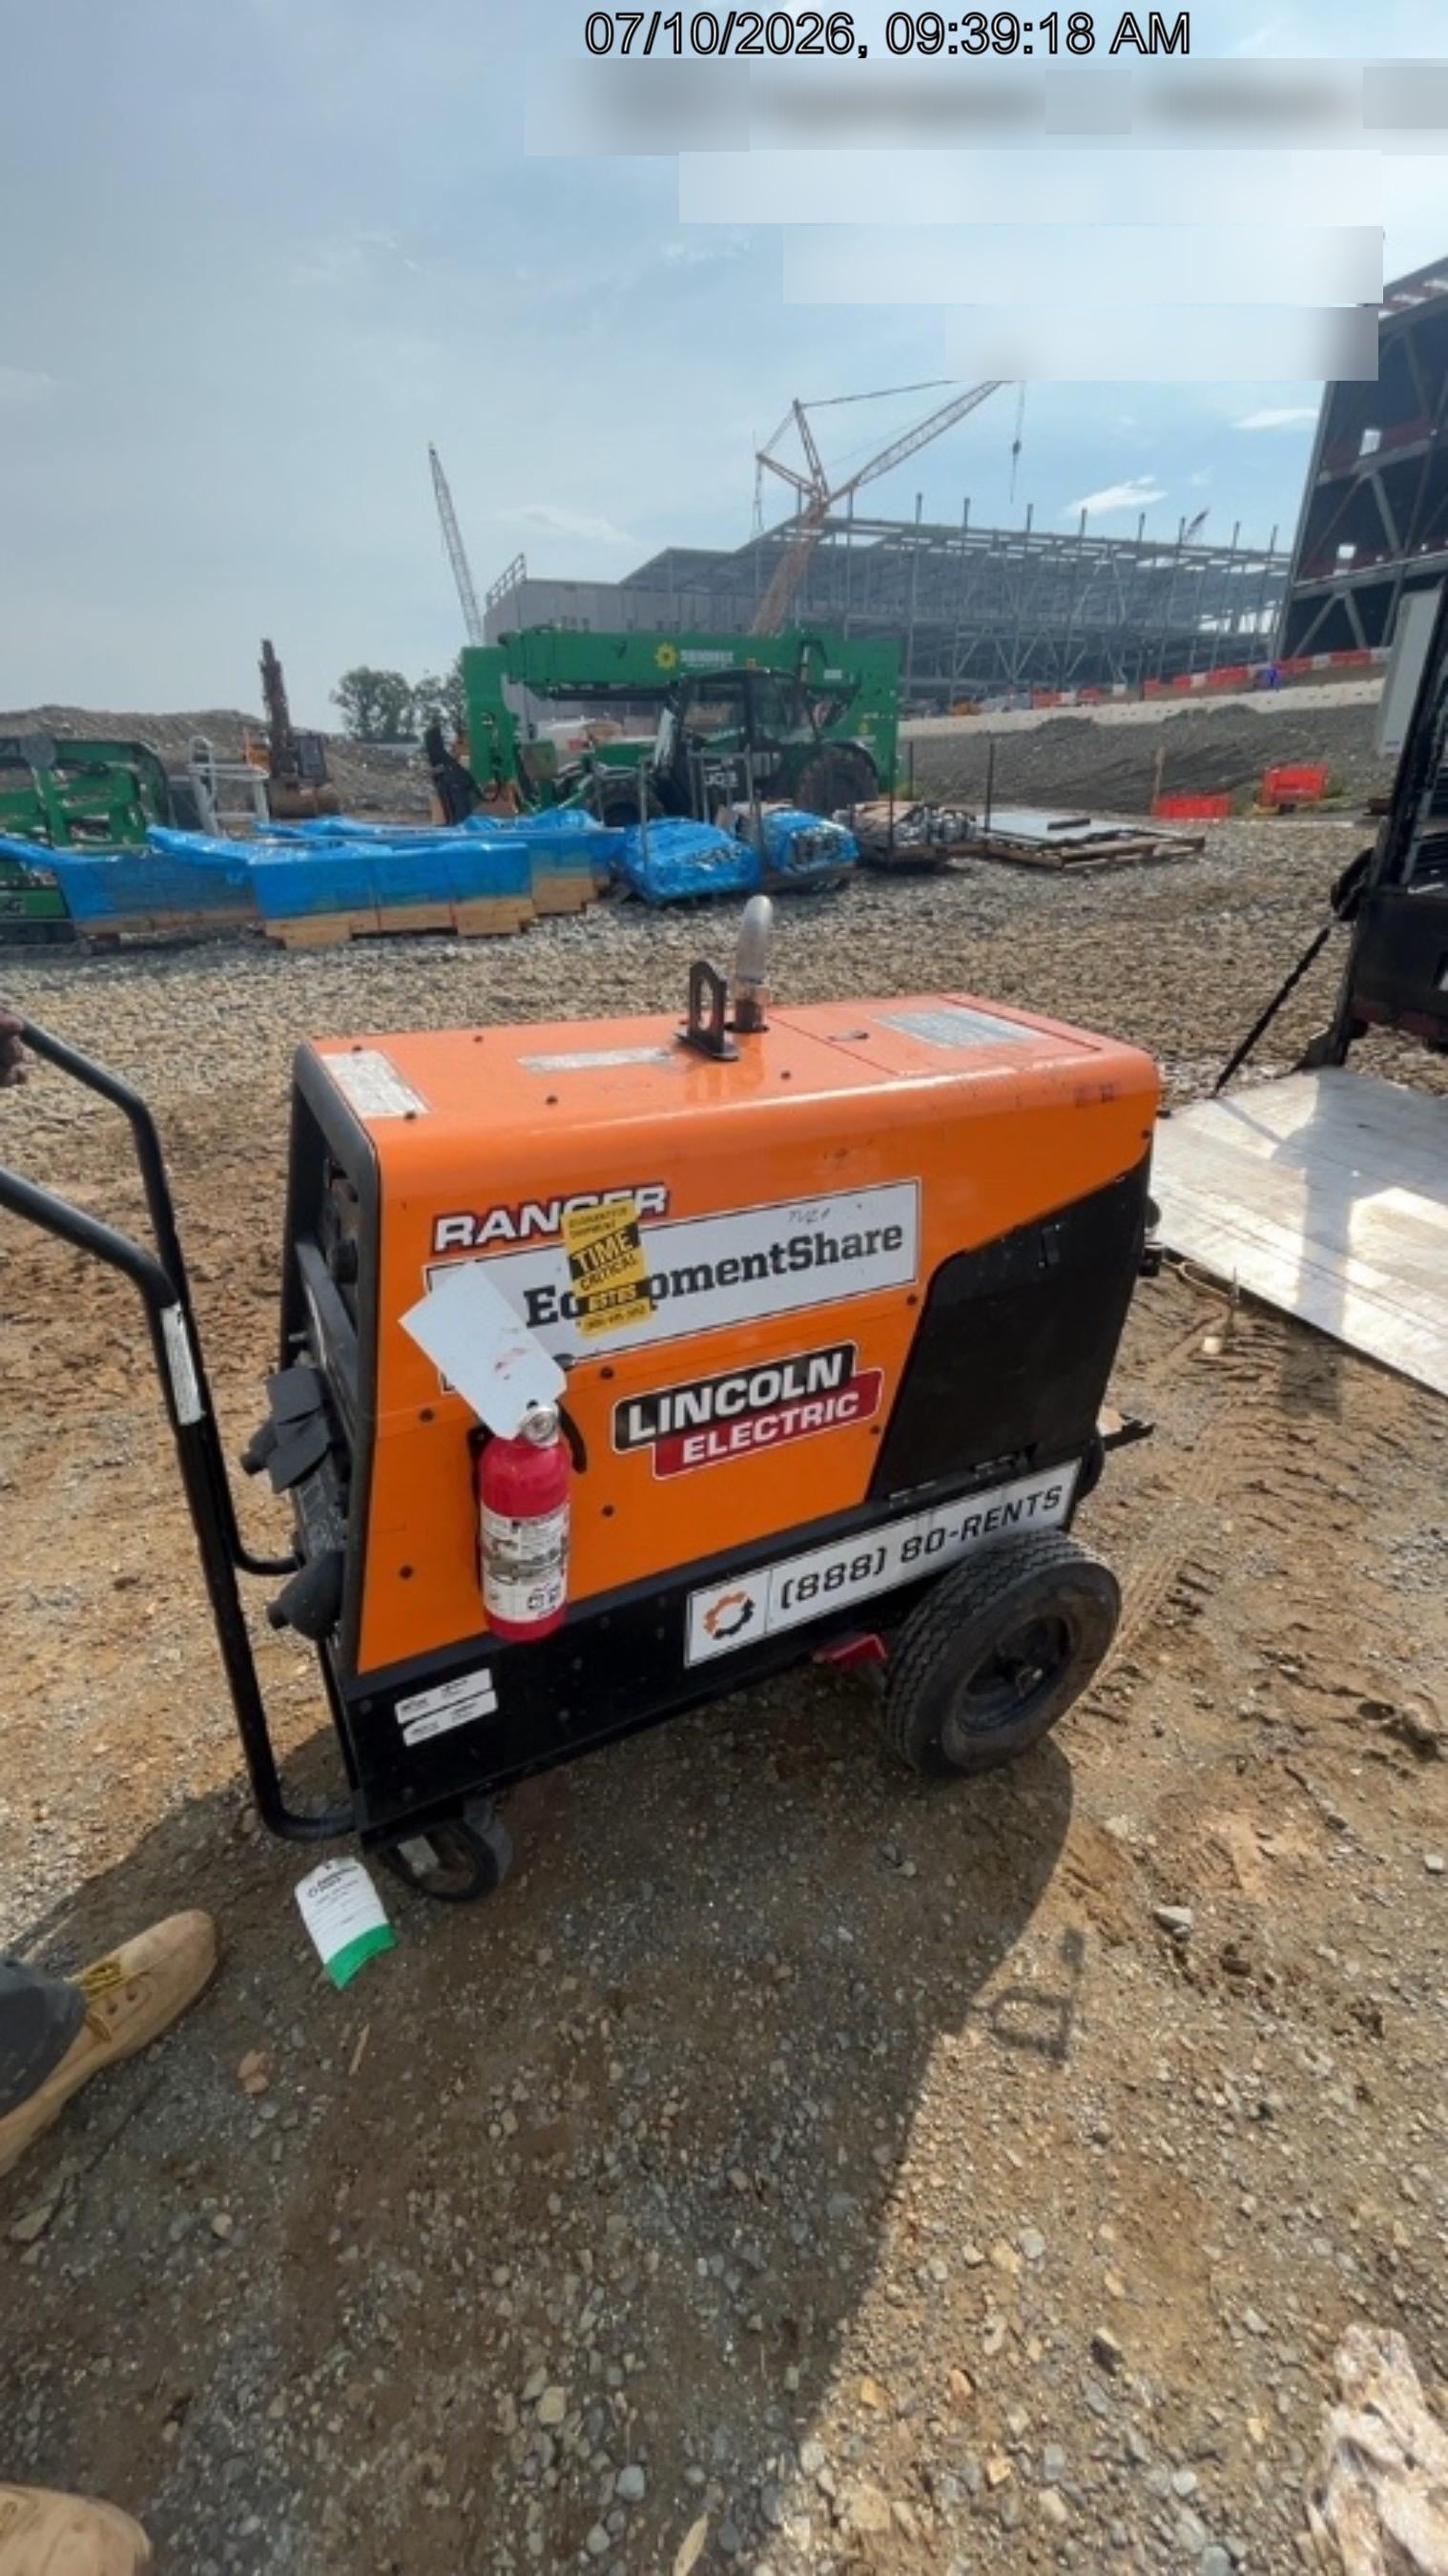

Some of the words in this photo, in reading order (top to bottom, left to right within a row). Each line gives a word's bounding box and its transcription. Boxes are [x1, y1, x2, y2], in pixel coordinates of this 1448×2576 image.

[523, 1223, 903, 1328] EpmentShare
[573, 1231, 632, 1273] TIME
[628, 1353, 843, 1442] LINCOLN
[682, 1392, 859, 1464] ELECTRIC
[779, 1546, 887, 1610] (888)
[900, 1485, 1064, 1564] 80-RENTS
